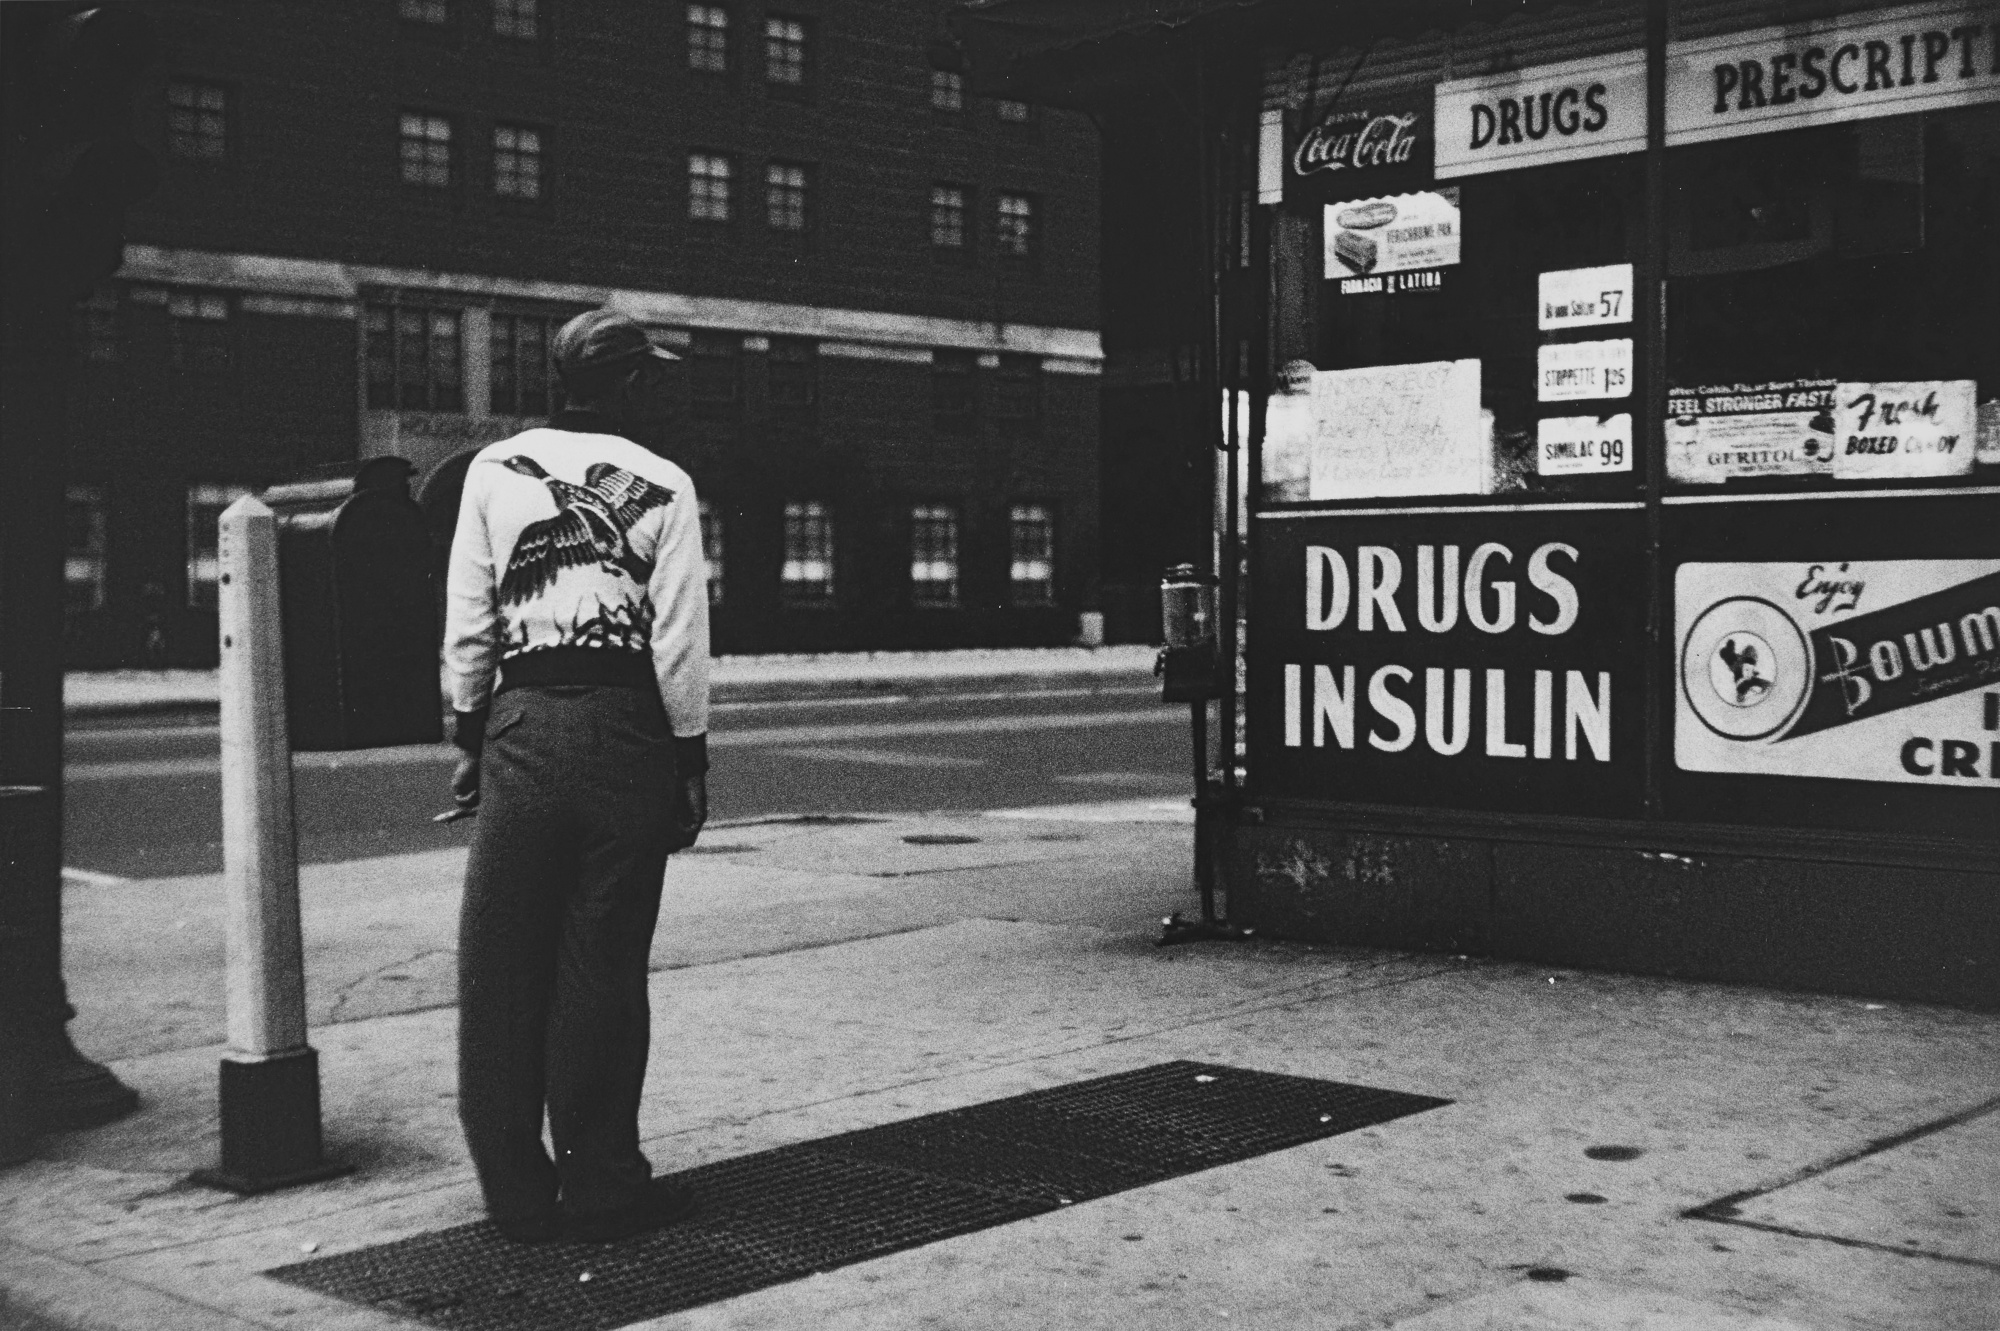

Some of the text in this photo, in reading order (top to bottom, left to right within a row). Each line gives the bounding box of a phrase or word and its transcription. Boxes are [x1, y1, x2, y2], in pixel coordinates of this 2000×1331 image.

[1469, 84, 1608, 149] DRUGS
[1600, 289, 1624, 318] 57
[1545, 367, 1595, 387] STOPPETTE
[1668, 398, 1702, 415] FEEL
[1705, 393, 1783, 413] STRONGER
[1545, 439, 1624, 466] SIMILAC 99
[1707, 449, 1795, 466] GERITOL
[1845, 434, 1960, 455] BOXED CADY
[1306, 542, 1579, 635] DRUGS
[1796, 563, 1866, 614] Enjoy
[1285, 664, 1610, 762] INSULIN
